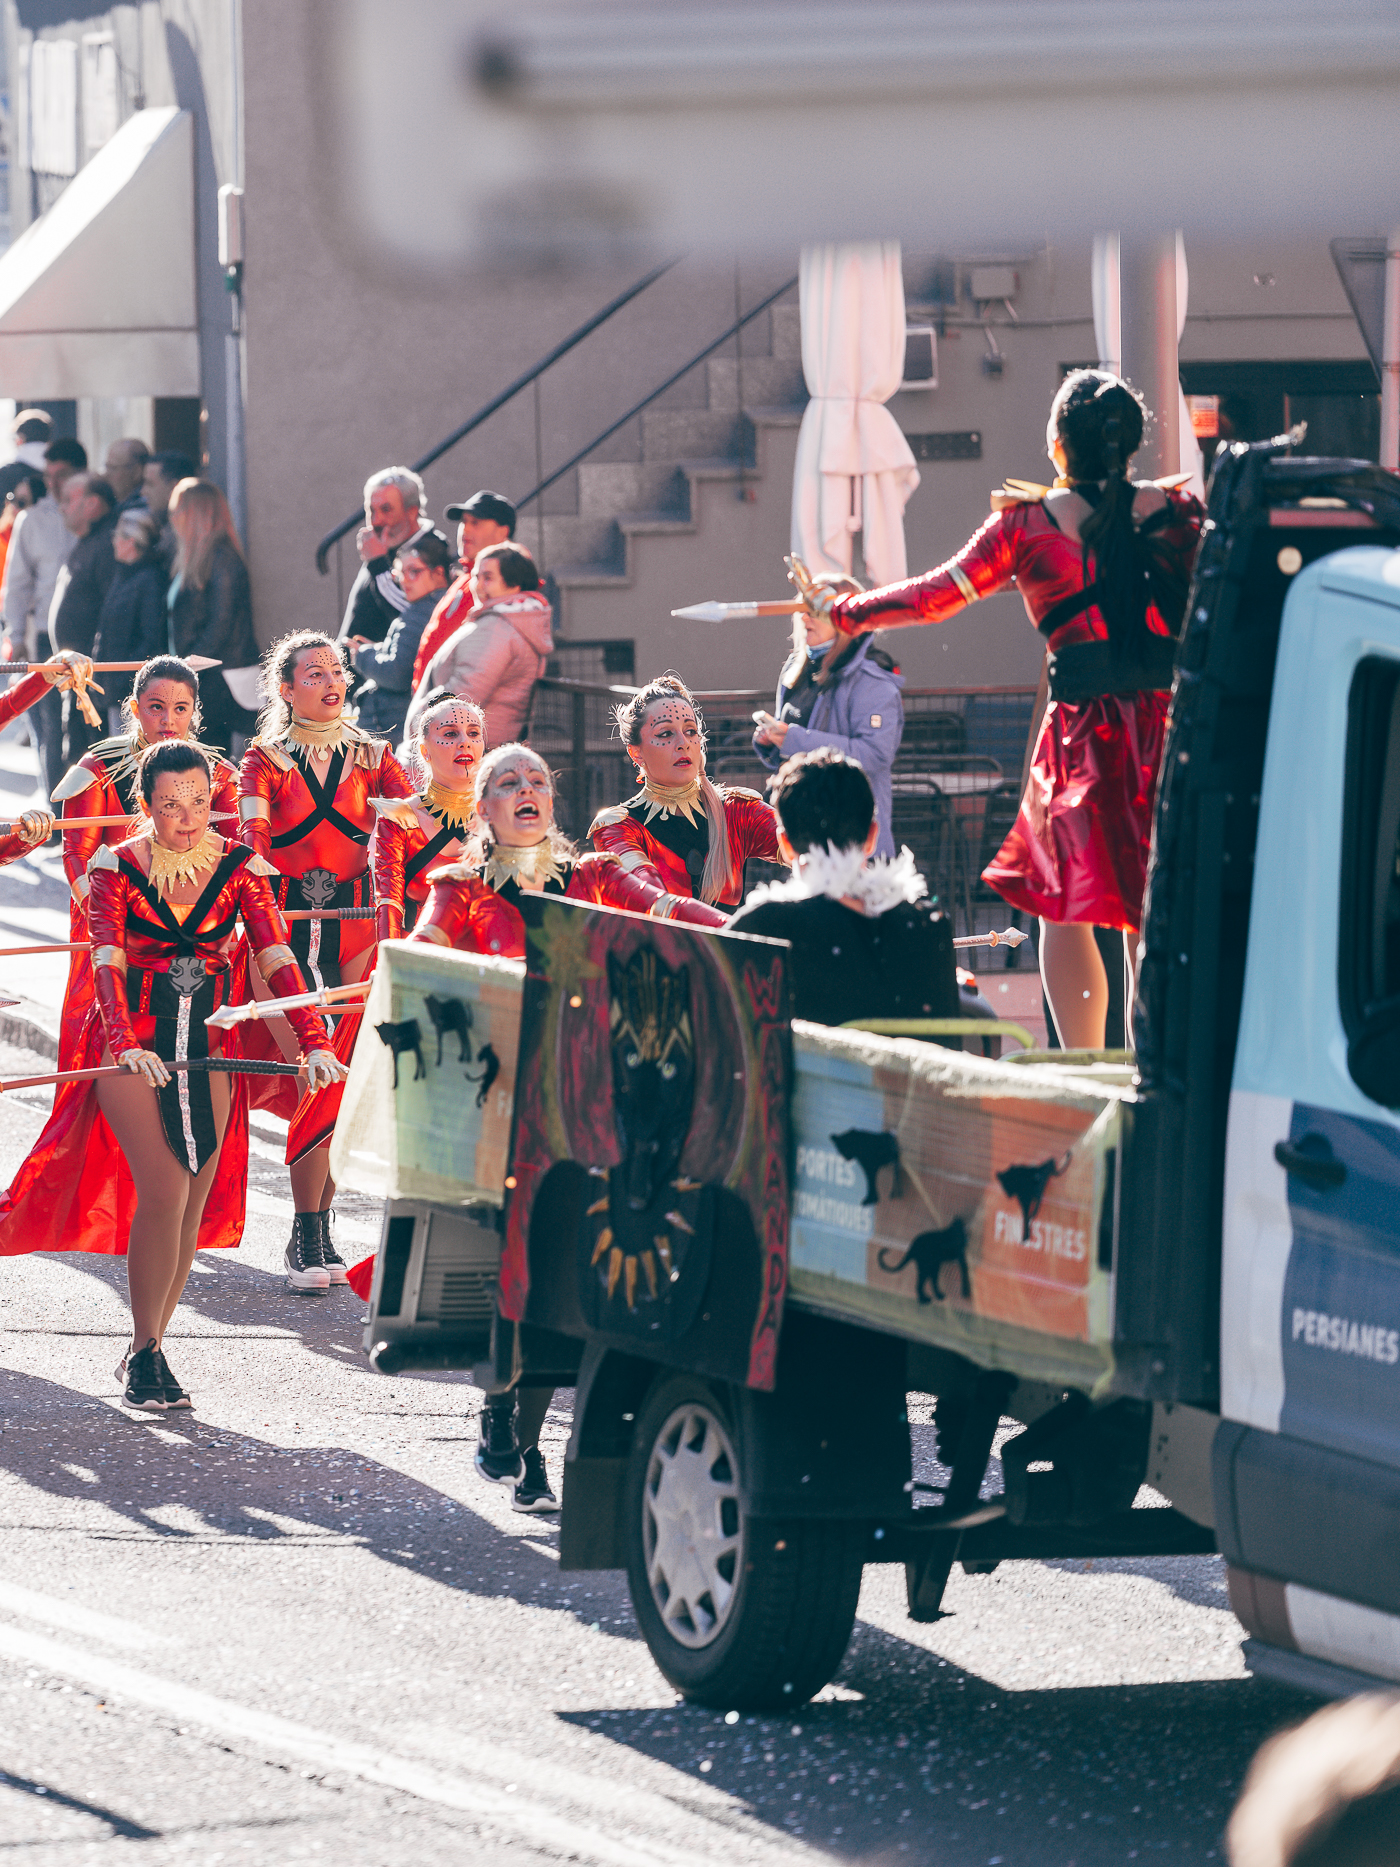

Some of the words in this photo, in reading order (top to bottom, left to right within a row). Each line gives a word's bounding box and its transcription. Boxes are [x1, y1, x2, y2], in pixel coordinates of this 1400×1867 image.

[796, 1146, 856, 1188] PORTES
[995, 1211, 1086, 1261] FINSTRES
[1292, 1307, 1399, 1366] PERSIANES
